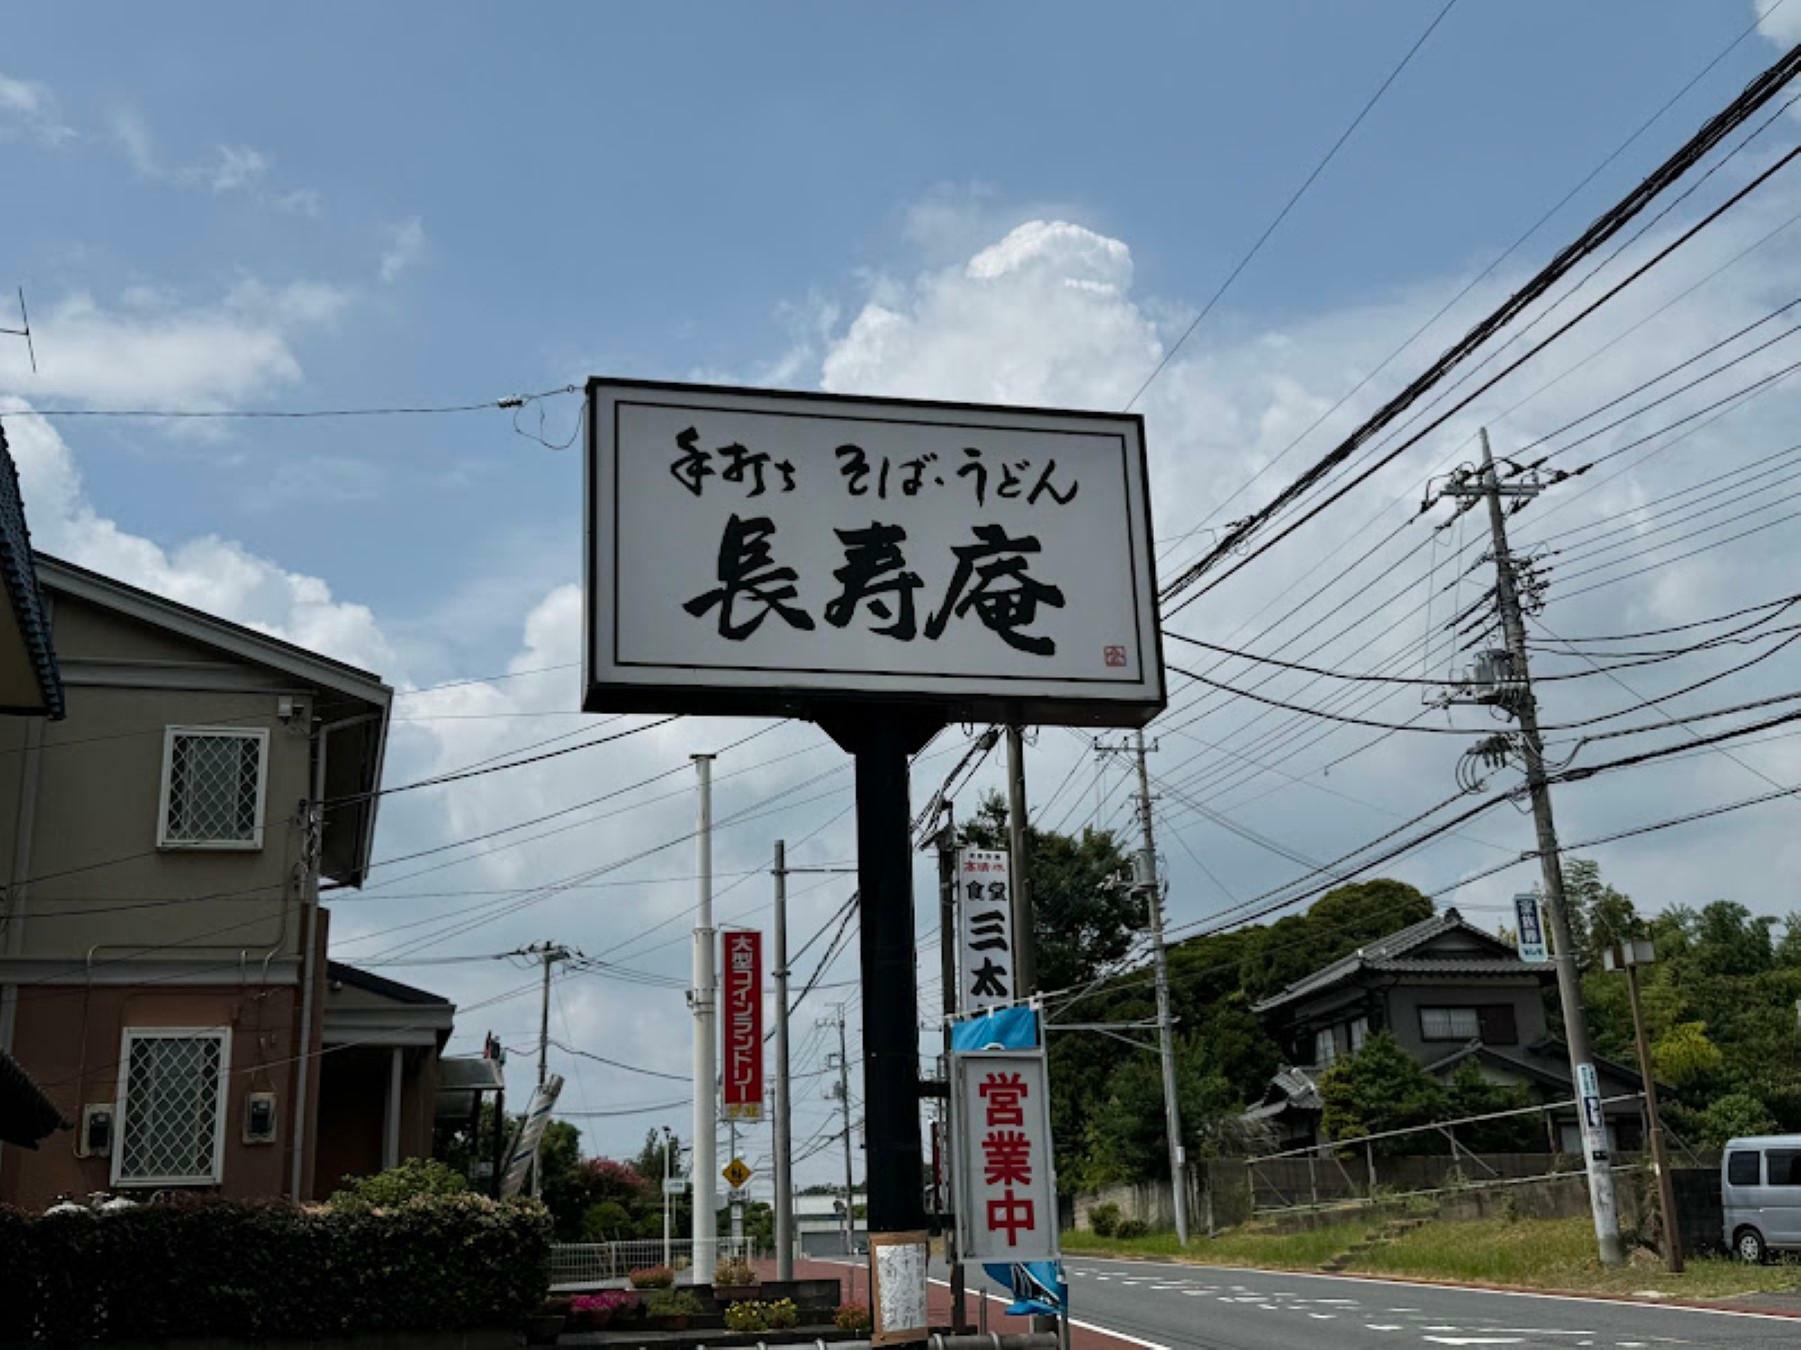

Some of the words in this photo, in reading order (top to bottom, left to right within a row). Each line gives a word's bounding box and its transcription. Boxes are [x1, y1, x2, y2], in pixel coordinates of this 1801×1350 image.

[670, 426, 795, 498] 手打ち
[682, 513, 1065, 656] 長寿庵
[966, 880, 1007, 901] 食堂
[731, 935, 754, 1101] 大型コインランドリー
[968, 909, 1008, 1017] 三太
[979, 1071, 1035, 1247] 営業中
